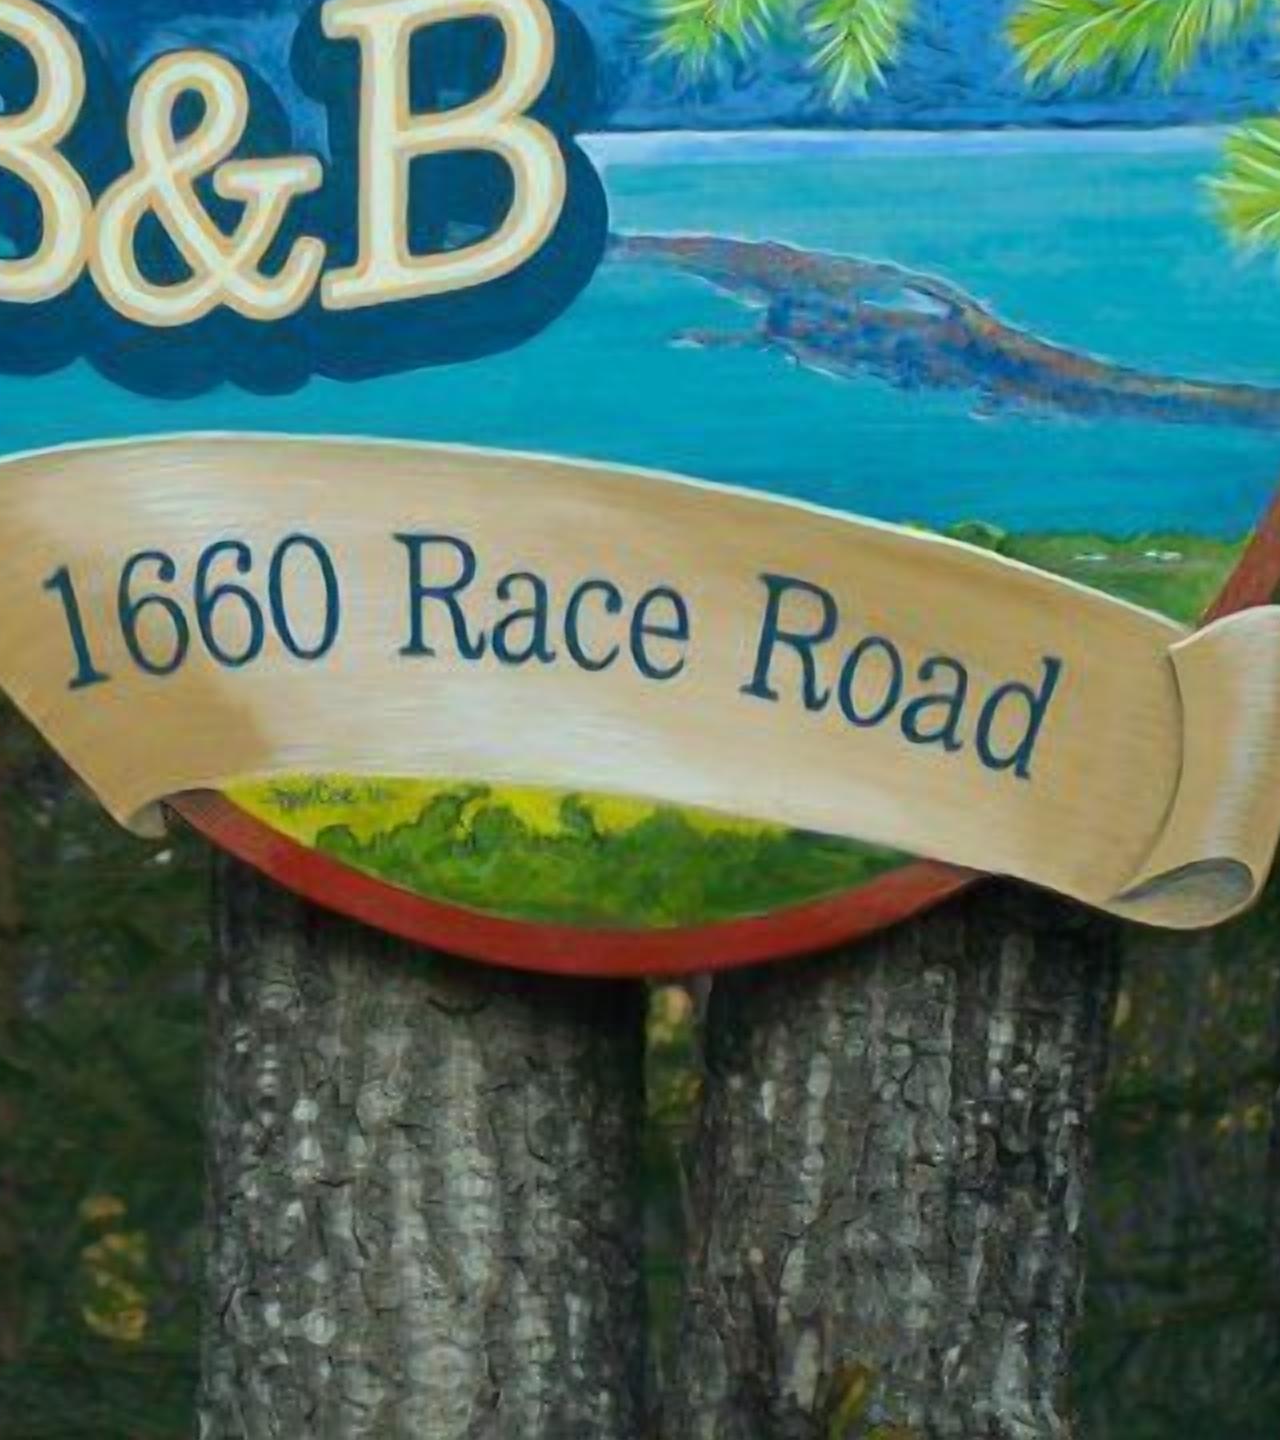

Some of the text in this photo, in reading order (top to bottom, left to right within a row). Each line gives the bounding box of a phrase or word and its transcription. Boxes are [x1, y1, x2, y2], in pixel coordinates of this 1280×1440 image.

[42, 531, 1063, 781] 1660 Race Road
